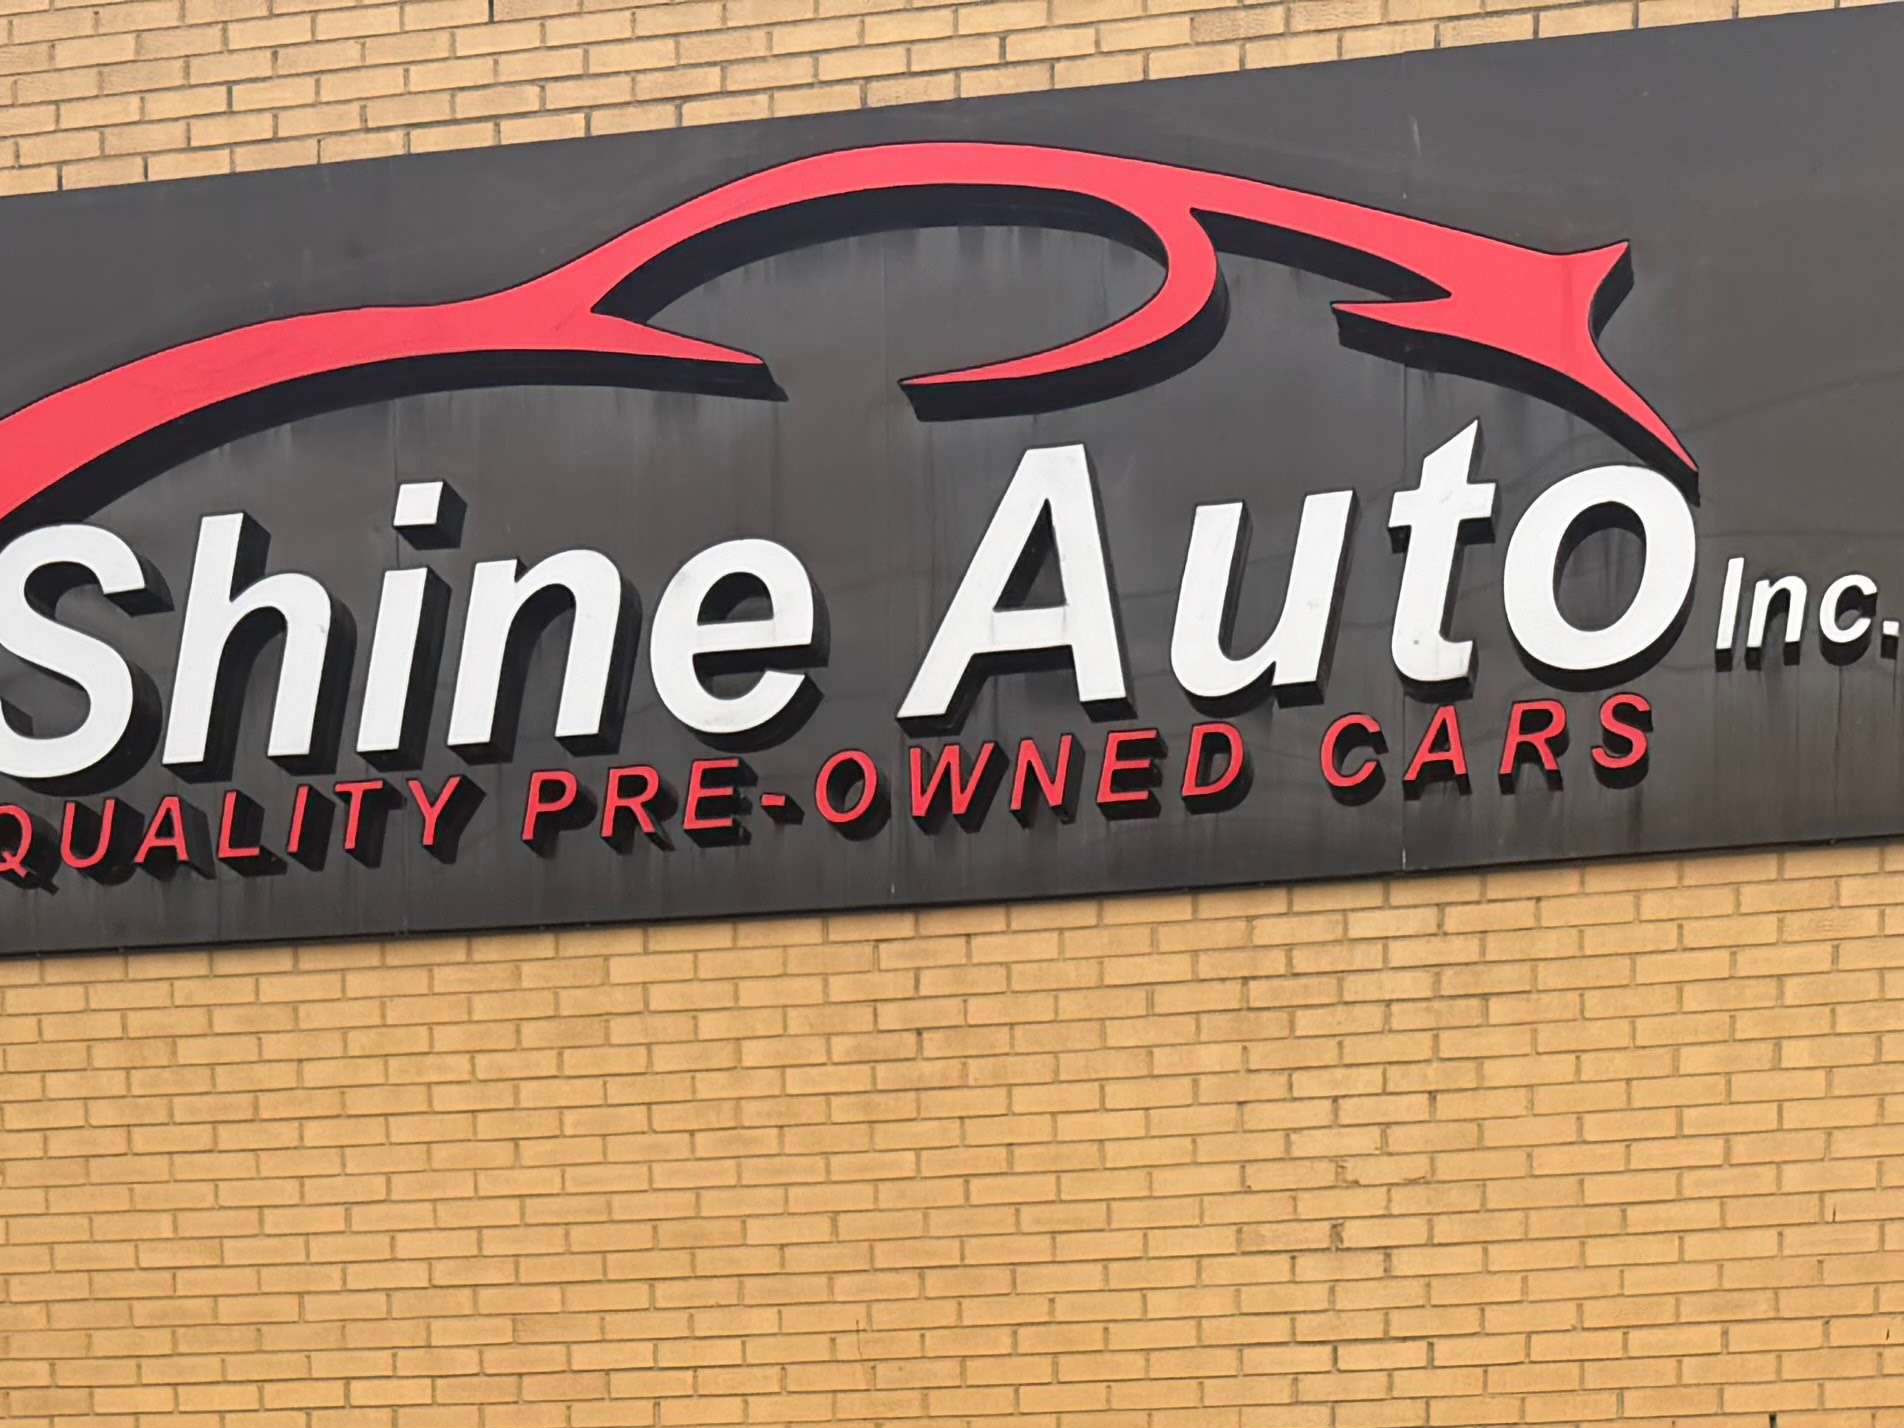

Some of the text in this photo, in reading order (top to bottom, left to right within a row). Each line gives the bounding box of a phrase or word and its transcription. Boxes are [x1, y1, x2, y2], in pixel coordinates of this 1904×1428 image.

[897, 419, 1698, 719] Auto
[1714, 556, 1901, 648] Inc.
[521, 721, 1245, 842] PRE-OWNED
[1318, 692, 1652, 788] CARS
